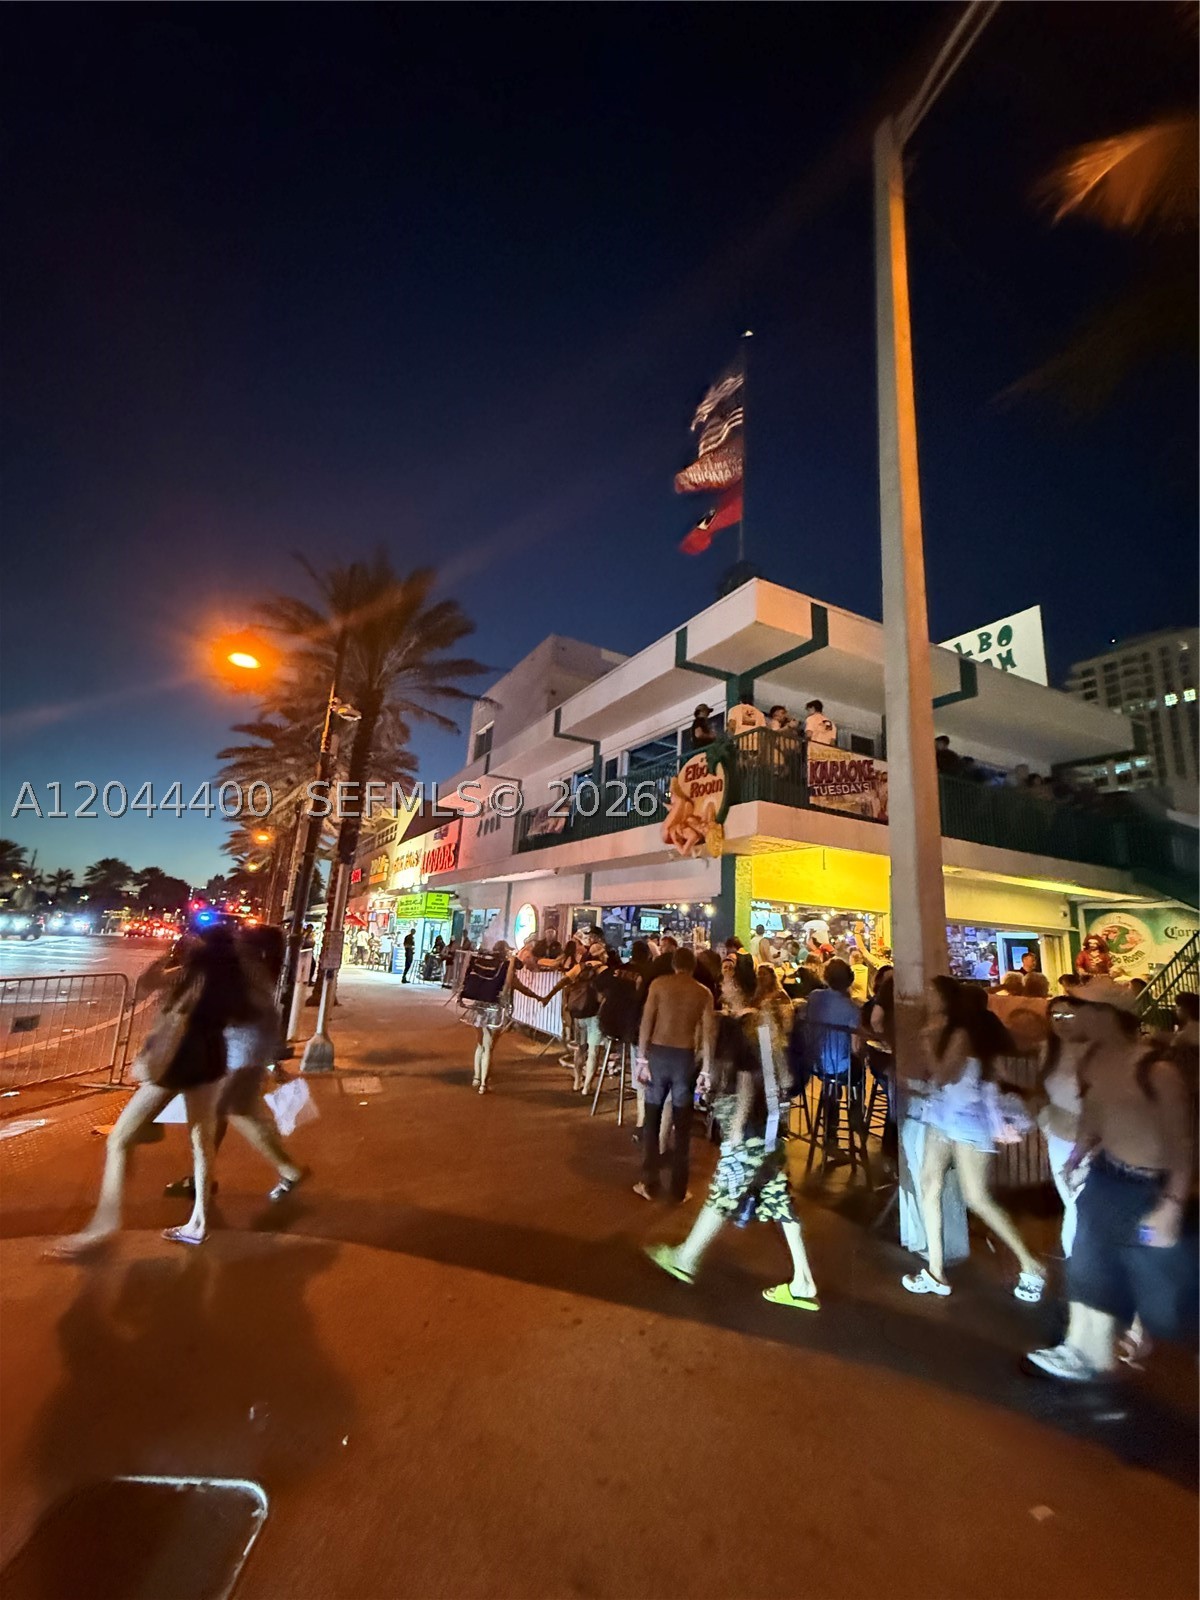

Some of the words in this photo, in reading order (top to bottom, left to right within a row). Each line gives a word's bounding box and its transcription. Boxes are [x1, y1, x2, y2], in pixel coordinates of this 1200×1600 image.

[808, 760, 875, 784] KARAOKE
[690, 779, 724, 798] Room
[812, 782, 870, 797] TUESDAYS
